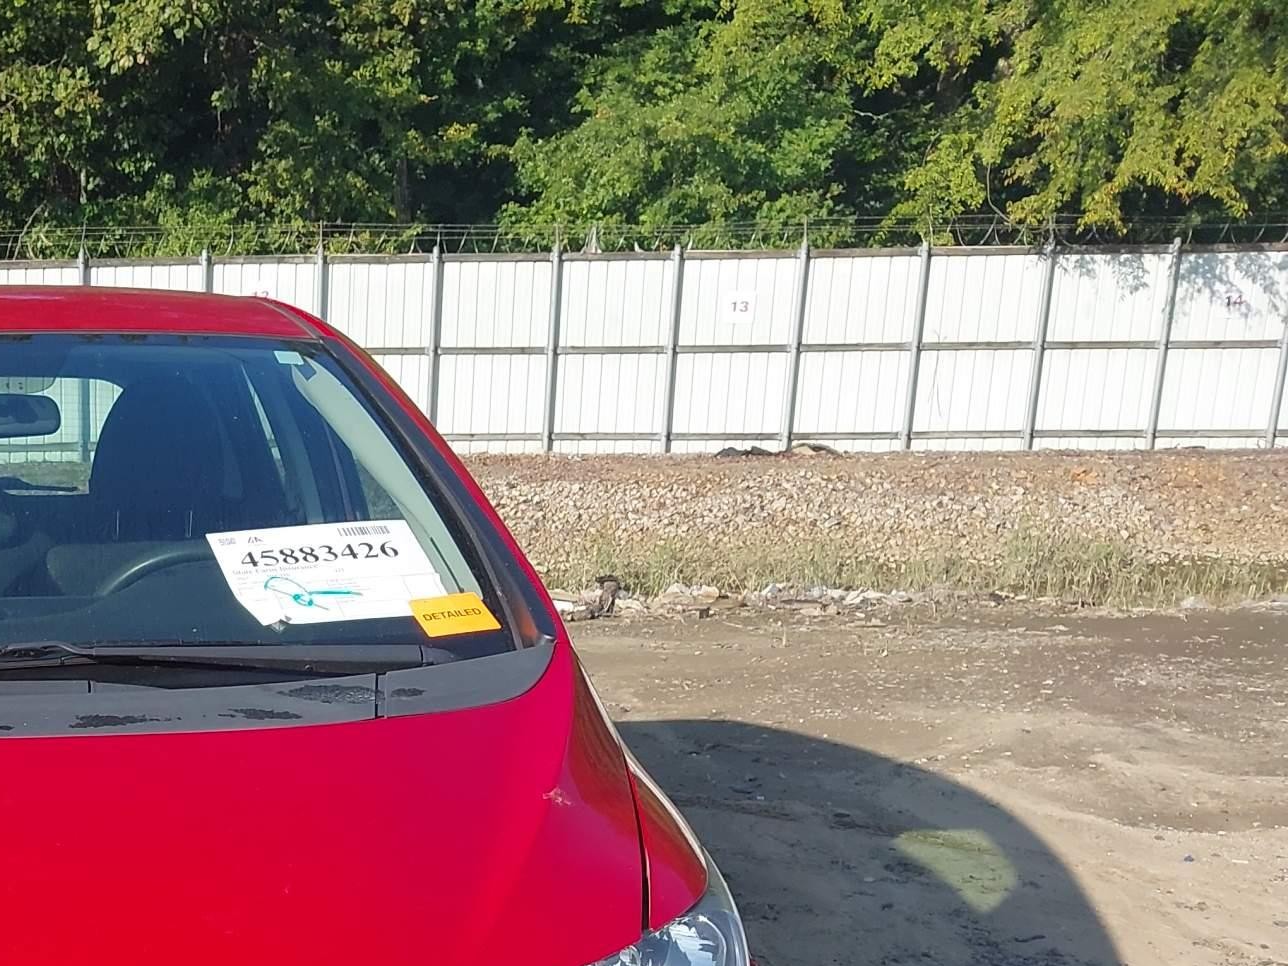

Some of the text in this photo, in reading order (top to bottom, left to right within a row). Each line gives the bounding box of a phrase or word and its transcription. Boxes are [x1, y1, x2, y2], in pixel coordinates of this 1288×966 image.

[731, 301, 749, 313] 13
[240, 540, 399, 567] 45883426
[422, 607, 482, 621] DETAILED
